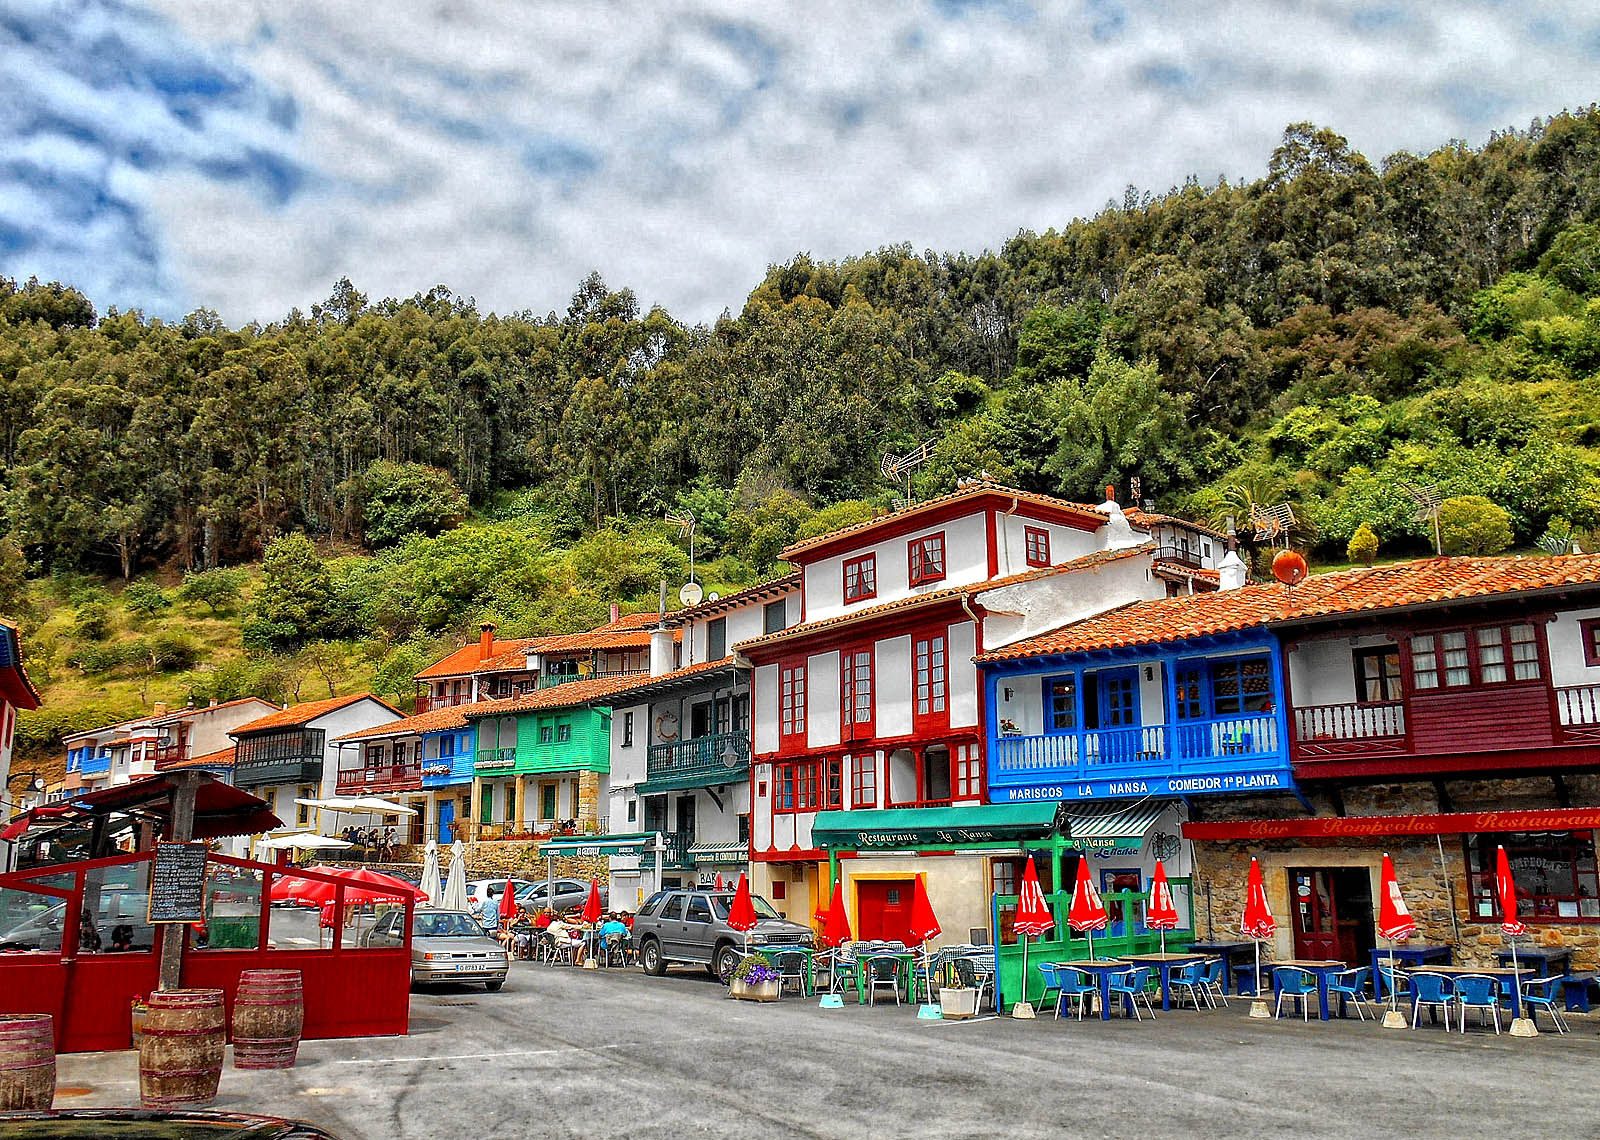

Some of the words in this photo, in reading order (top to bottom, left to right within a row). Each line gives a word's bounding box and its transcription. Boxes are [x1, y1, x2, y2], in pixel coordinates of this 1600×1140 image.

[1009, 787, 1063, 800] MARISCOS
[1078, 785, 1093, 796] LA
[1109, 782, 1148, 794] NANSA
[1168, 779, 1222, 791] COMEDOR
[1236, 774, 1279, 787] PLANTA
[1249, 821, 1289, 835] Bar
[1322, 817, 1437, 835] Rompeolas
[857, 831, 918, 846] Restaurante
[957, 829, 993, 841] Nansa
[1083, 837, 1115, 849] Nansa
[700, 873, 717, 884] BAR
